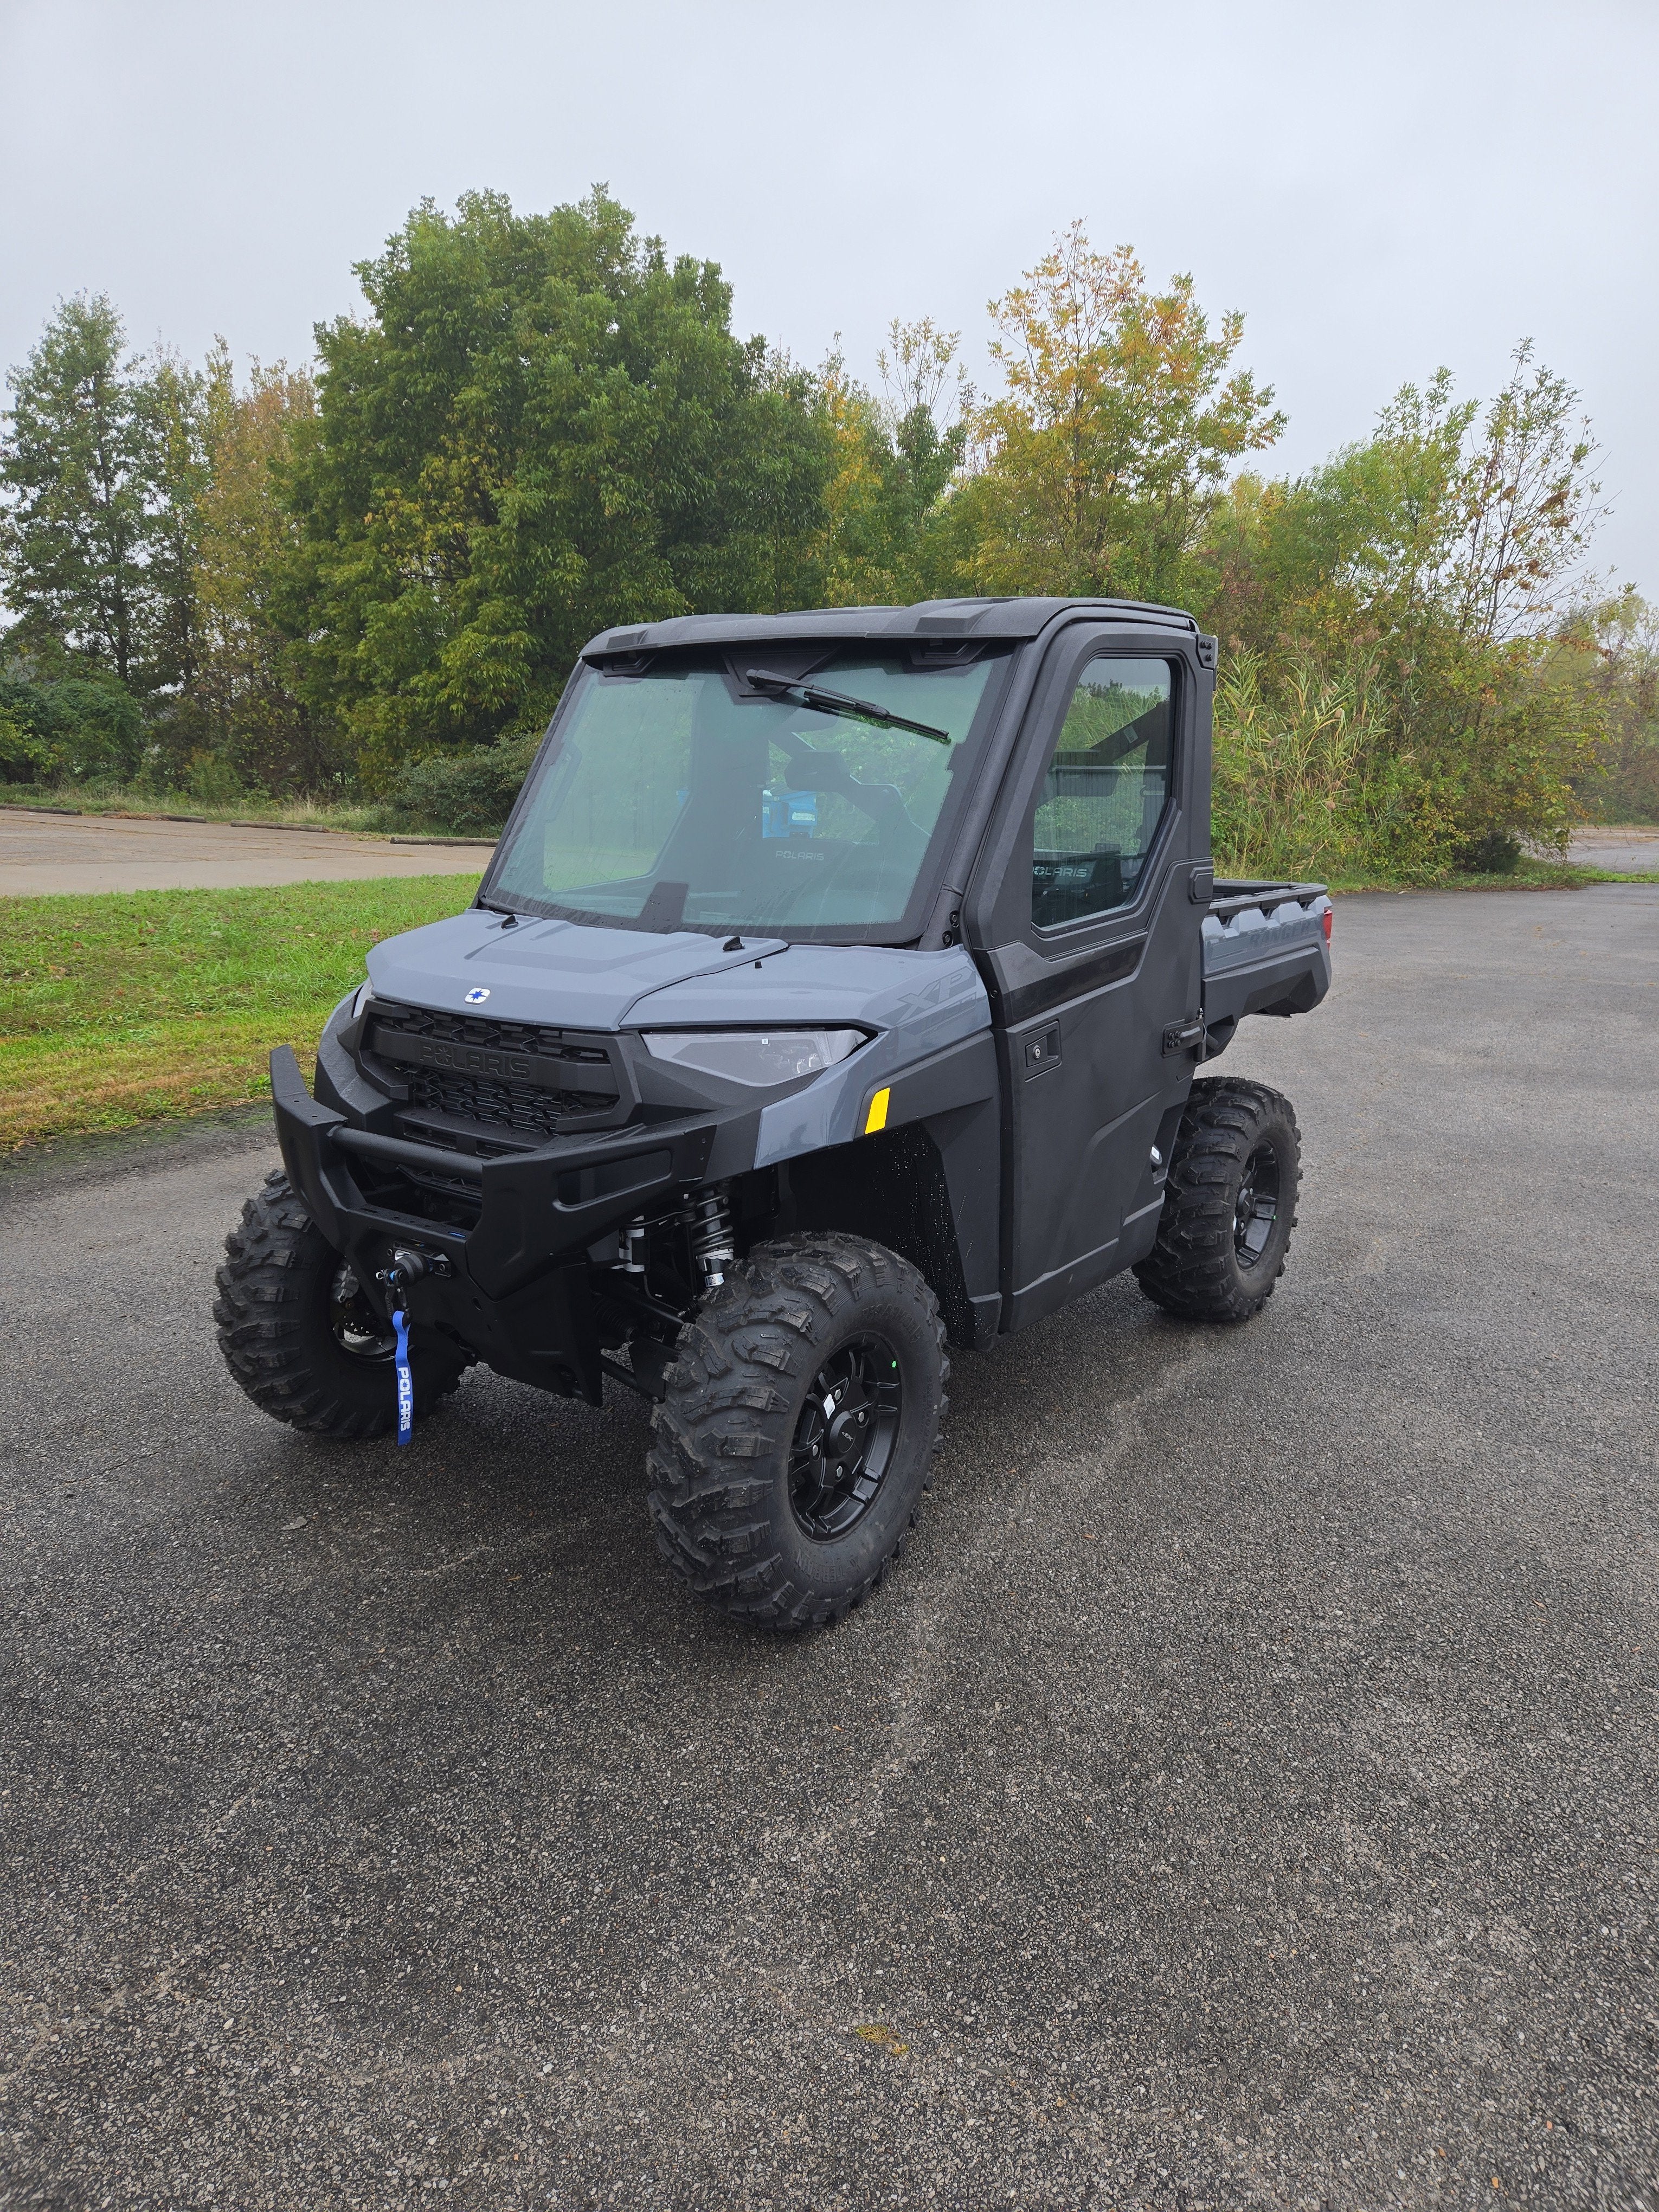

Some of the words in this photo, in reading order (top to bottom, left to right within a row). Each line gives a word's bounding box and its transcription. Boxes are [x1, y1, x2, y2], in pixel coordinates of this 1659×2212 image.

[775, 851, 825, 861] POLARIS
[1032, 866, 1087, 878] OLARIS
[1250, 919, 1311, 947] RANGER
[896, 966, 975, 1025] XP
[420, 1043, 530, 1080] POLARIS
[398, 1367, 410, 1431] POLARIS
